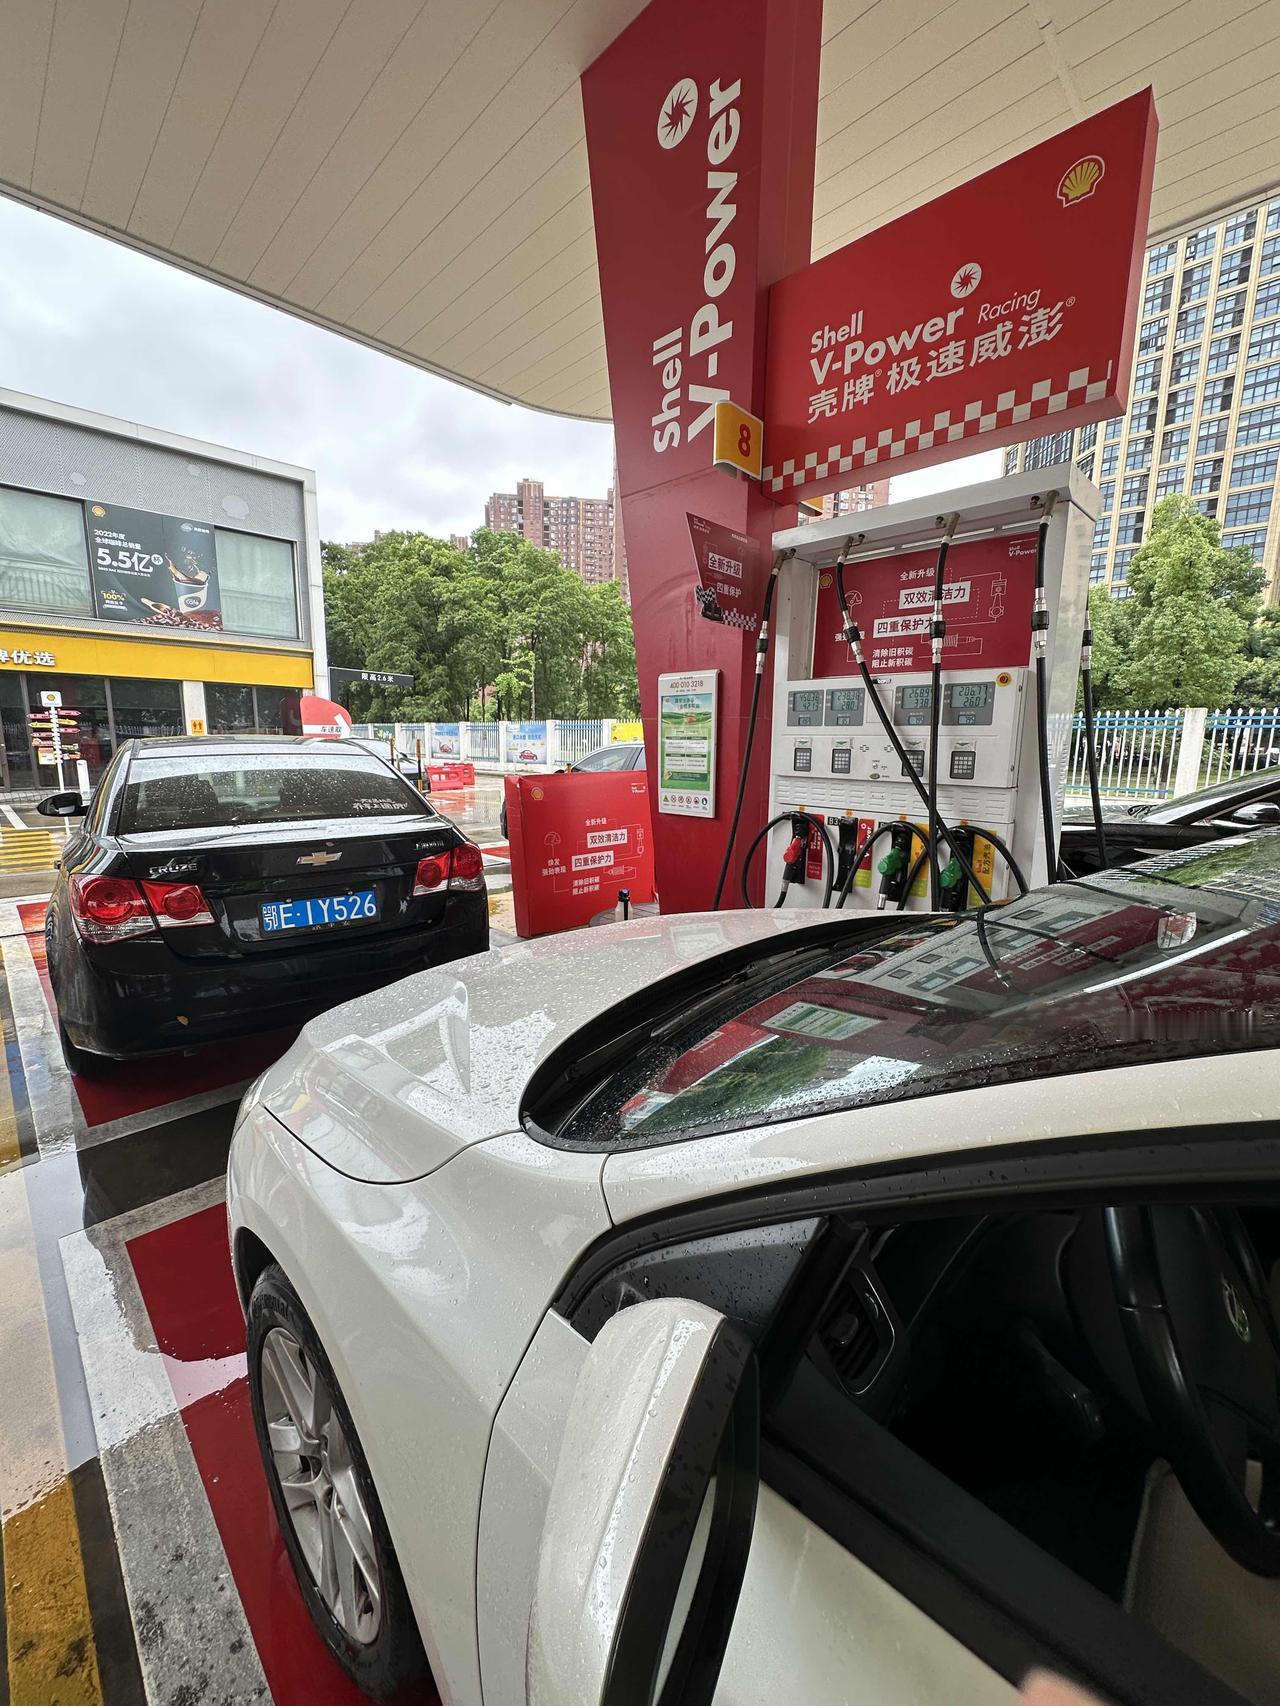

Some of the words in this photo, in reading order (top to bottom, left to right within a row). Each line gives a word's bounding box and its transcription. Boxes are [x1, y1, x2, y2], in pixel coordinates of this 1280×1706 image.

[688, 78, 742, 442] V-Power
[809, 310, 864, 354] Shell
[809, 307, 965, 386] V-Power
[977, 288, 1042, 325] Racing
[651, 326, 682, 453] Shell
[738, 423, 752, 457] 8
[900, 567, 935, 581] 全新升级
[872, 647, 914, 659] 清除旧积碳
[871, 657, 913, 669] 阻止新积碳
[589, 832, 626, 846] 双效清洁力
[149, 862, 197, 874] CRUZE
[574, 853, 612, 868] 四重保护力
